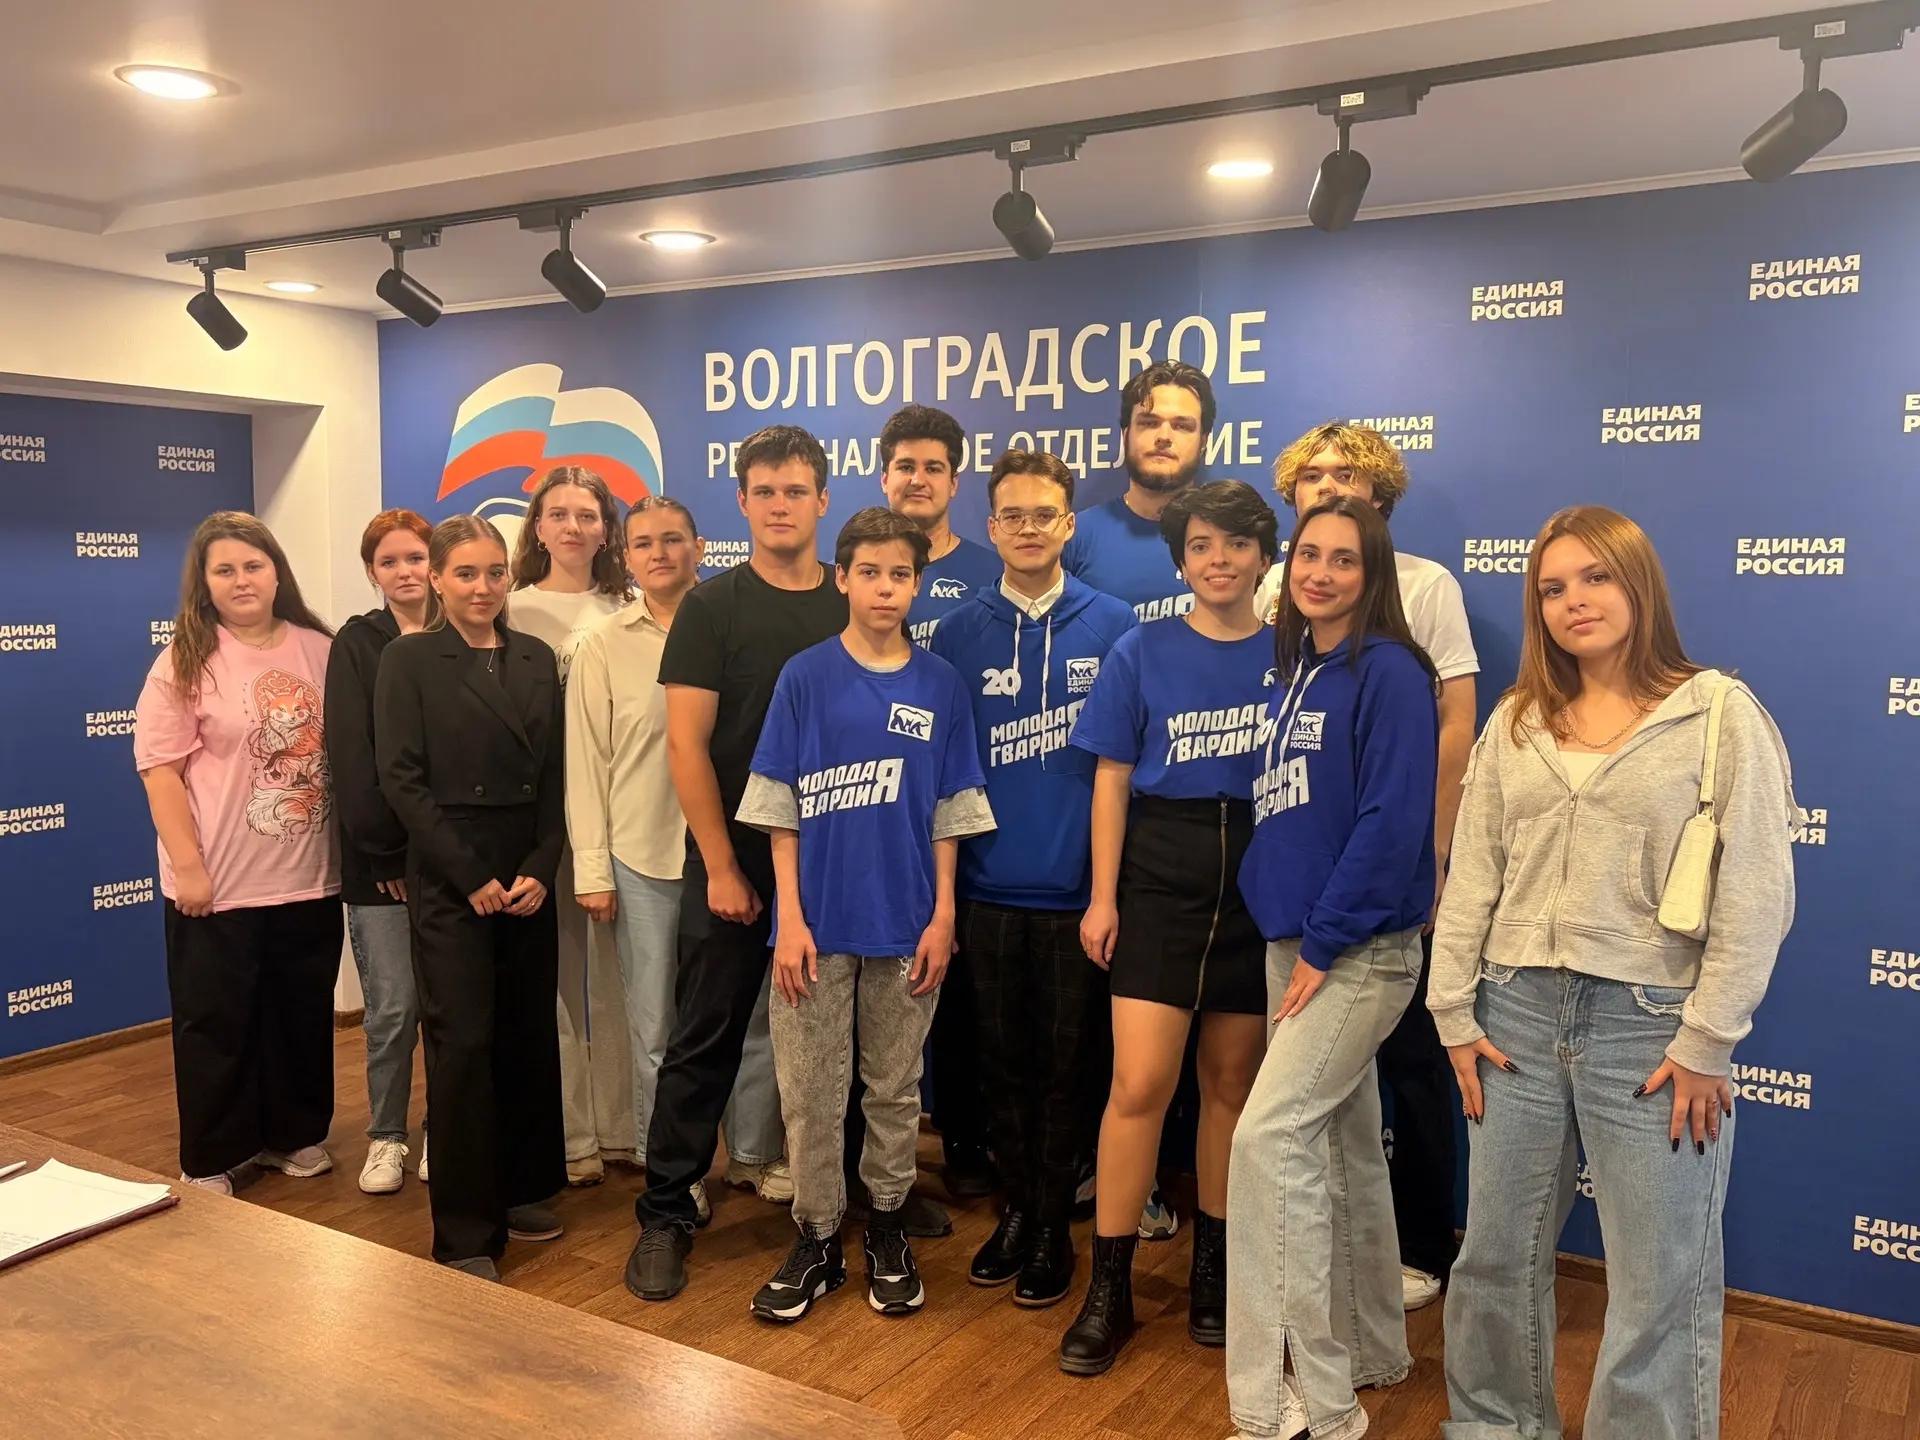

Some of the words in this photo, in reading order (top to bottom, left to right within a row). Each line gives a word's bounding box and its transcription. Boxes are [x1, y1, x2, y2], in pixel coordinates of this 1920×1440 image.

[1750, 254, 1861, 280] ЕДИНАЯ
[1472, 280, 1564, 302] ЕДИНАЯ
[1749, 275, 1860, 301] РОССИЯ
[1471, 299, 1563, 321] РОССИЯ
[705, 310, 1267, 412] ВОЛГОГРАДСКОЕ
[1602, 404, 1702, 425] ЕДИНАЯ
[0, 434, 45, 449] ИНАЯ
[1601, 424, 1701, 444] РОССИЯ
[0, 448, 46, 463] ССИЯ
[157, 445, 215, 460] ЕДИНАЯ
[158, 458, 216, 473] РОССИЯ
[76, 532, 138, 545] ЕДИНАЯ
[703, 541, 749, 554] ДИНАЯ
[1737, 537, 1846, 556] ЕДИНАЯ
[77, 545, 139, 558] РОССИЯ
[1463, 557, 1529, 574] РОСС
[1736, 557, 1845, 575] РОССИЯ
[0, 624, 56, 638] ДИНАЯ
[0, 637, 57, 651] ОССИЯ
[981, 668, 1022, 695] 20
[86, 710, 137, 725] ЕДИНА
[86, 723, 137, 738] РОССИ
[0, 803, 65, 823] ЕДИНАЯ
[0, 817, 65, 837] РОССИЯ
[93, 877, 153, 898] ЕДИНАЯ
[94, 890, 154, 911] РОССИЯ
[8, 979, 73, 1004] ЕДИНАЯ
[8, 992, 73, 1017] РОССИЯ
[1853, 1234, 1920, 1264] РОСС
